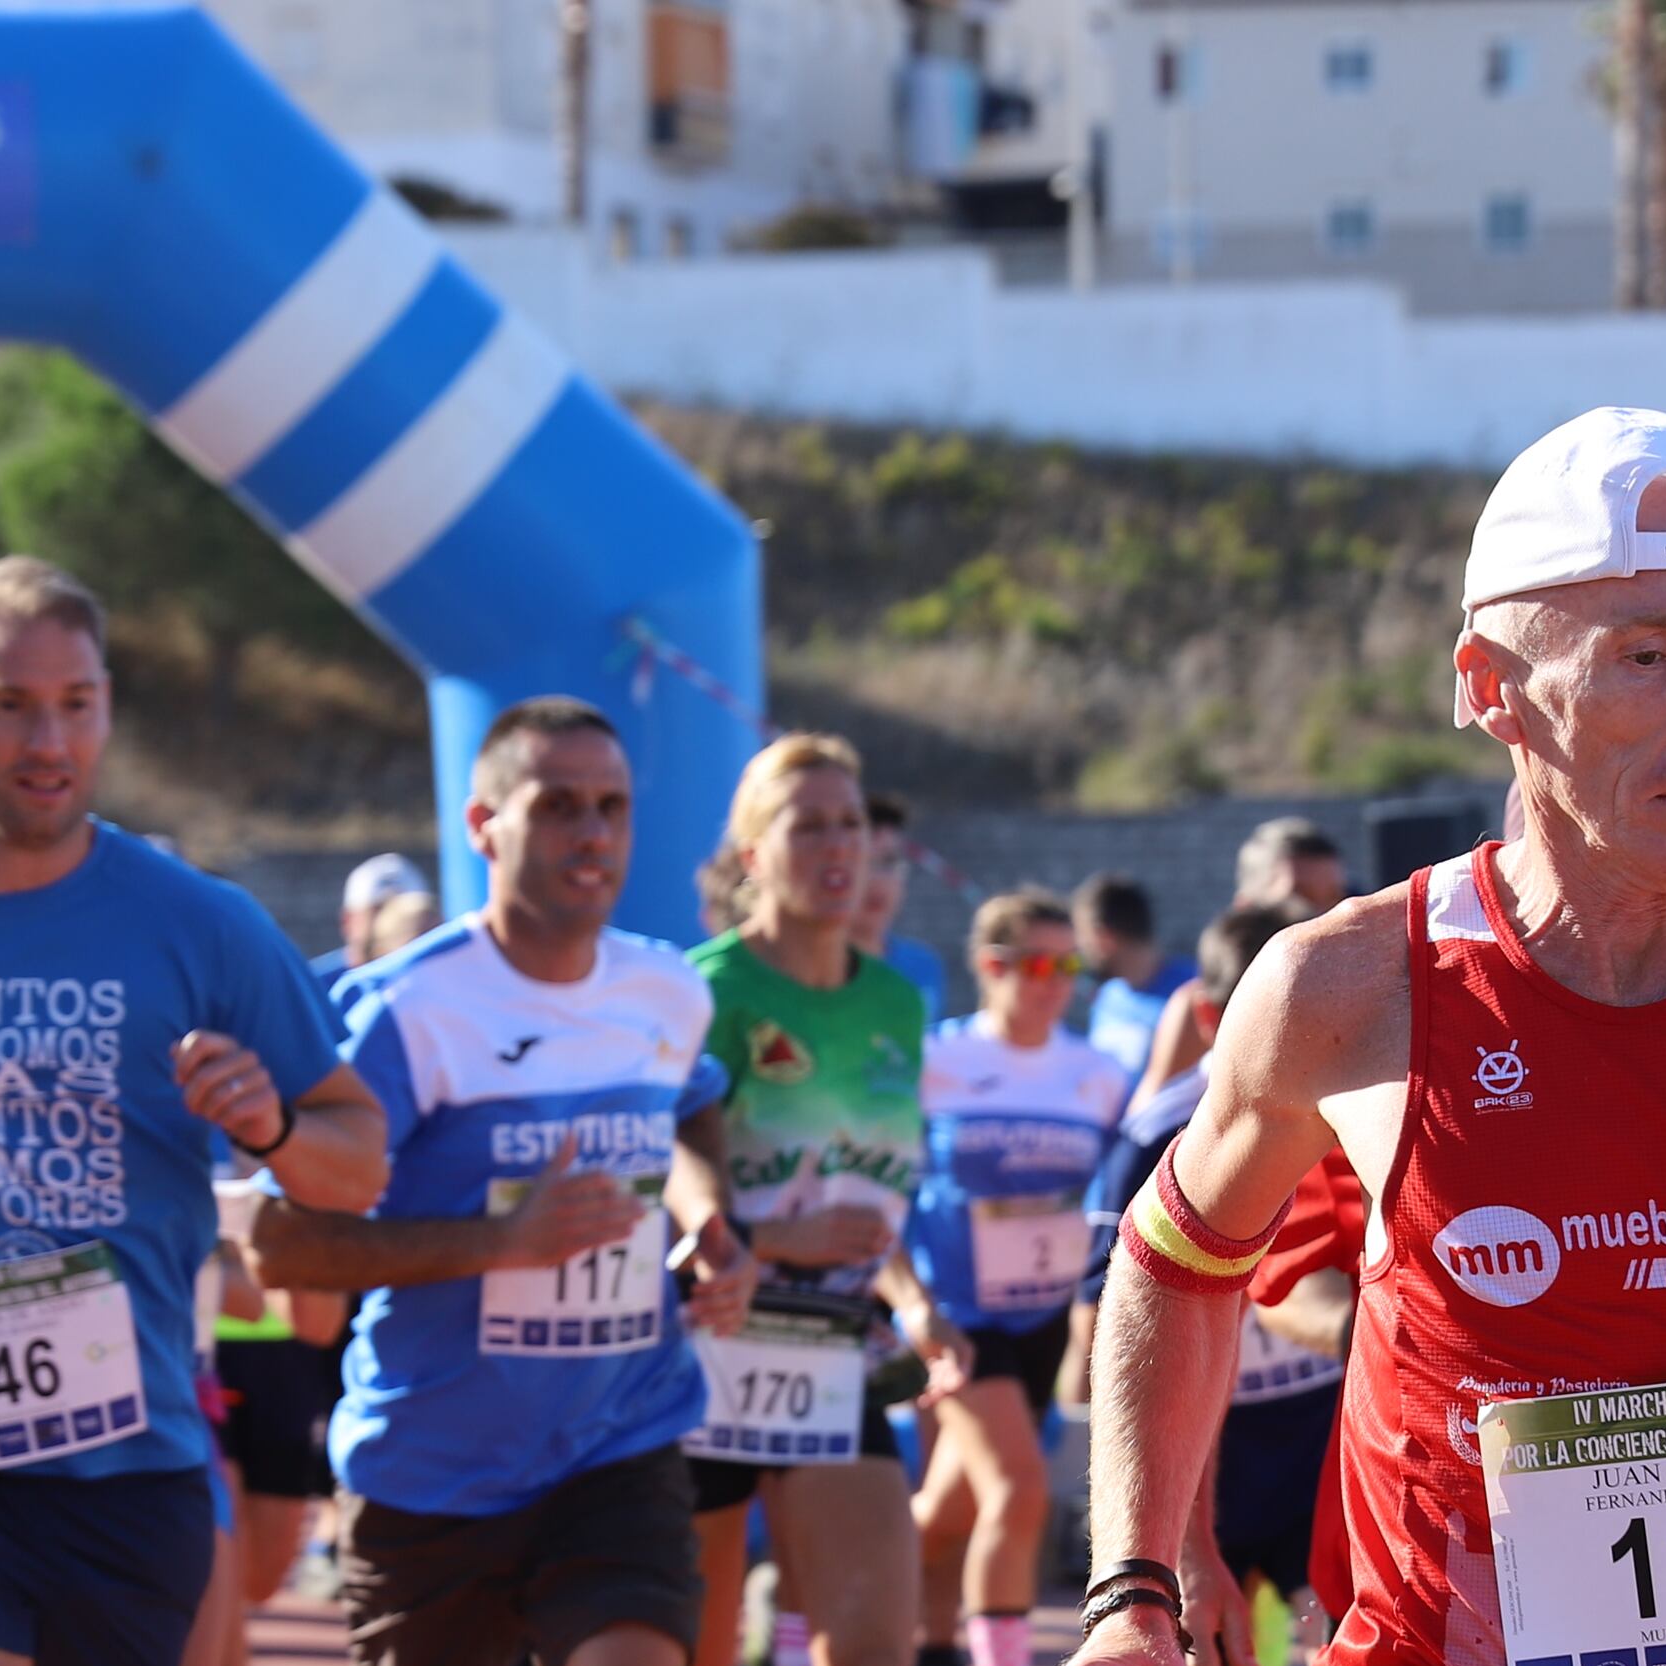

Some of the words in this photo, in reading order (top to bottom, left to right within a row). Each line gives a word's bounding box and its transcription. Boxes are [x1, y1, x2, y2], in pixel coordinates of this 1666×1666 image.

[1474, 1096, 1506, 1109] BRK
[1508, 1093, 1531, 1105] 23
[1448, 1239, 1543, 1276] mm
[736, 1368, 814, 1420] 170
[1573, 1398, 1593, 1426] IV
[1501, 1442, 1539, 1470] POR
[1545, 1439, 1569, 1466] LA
[1592, 1462, 1661, 1490] JUAN
